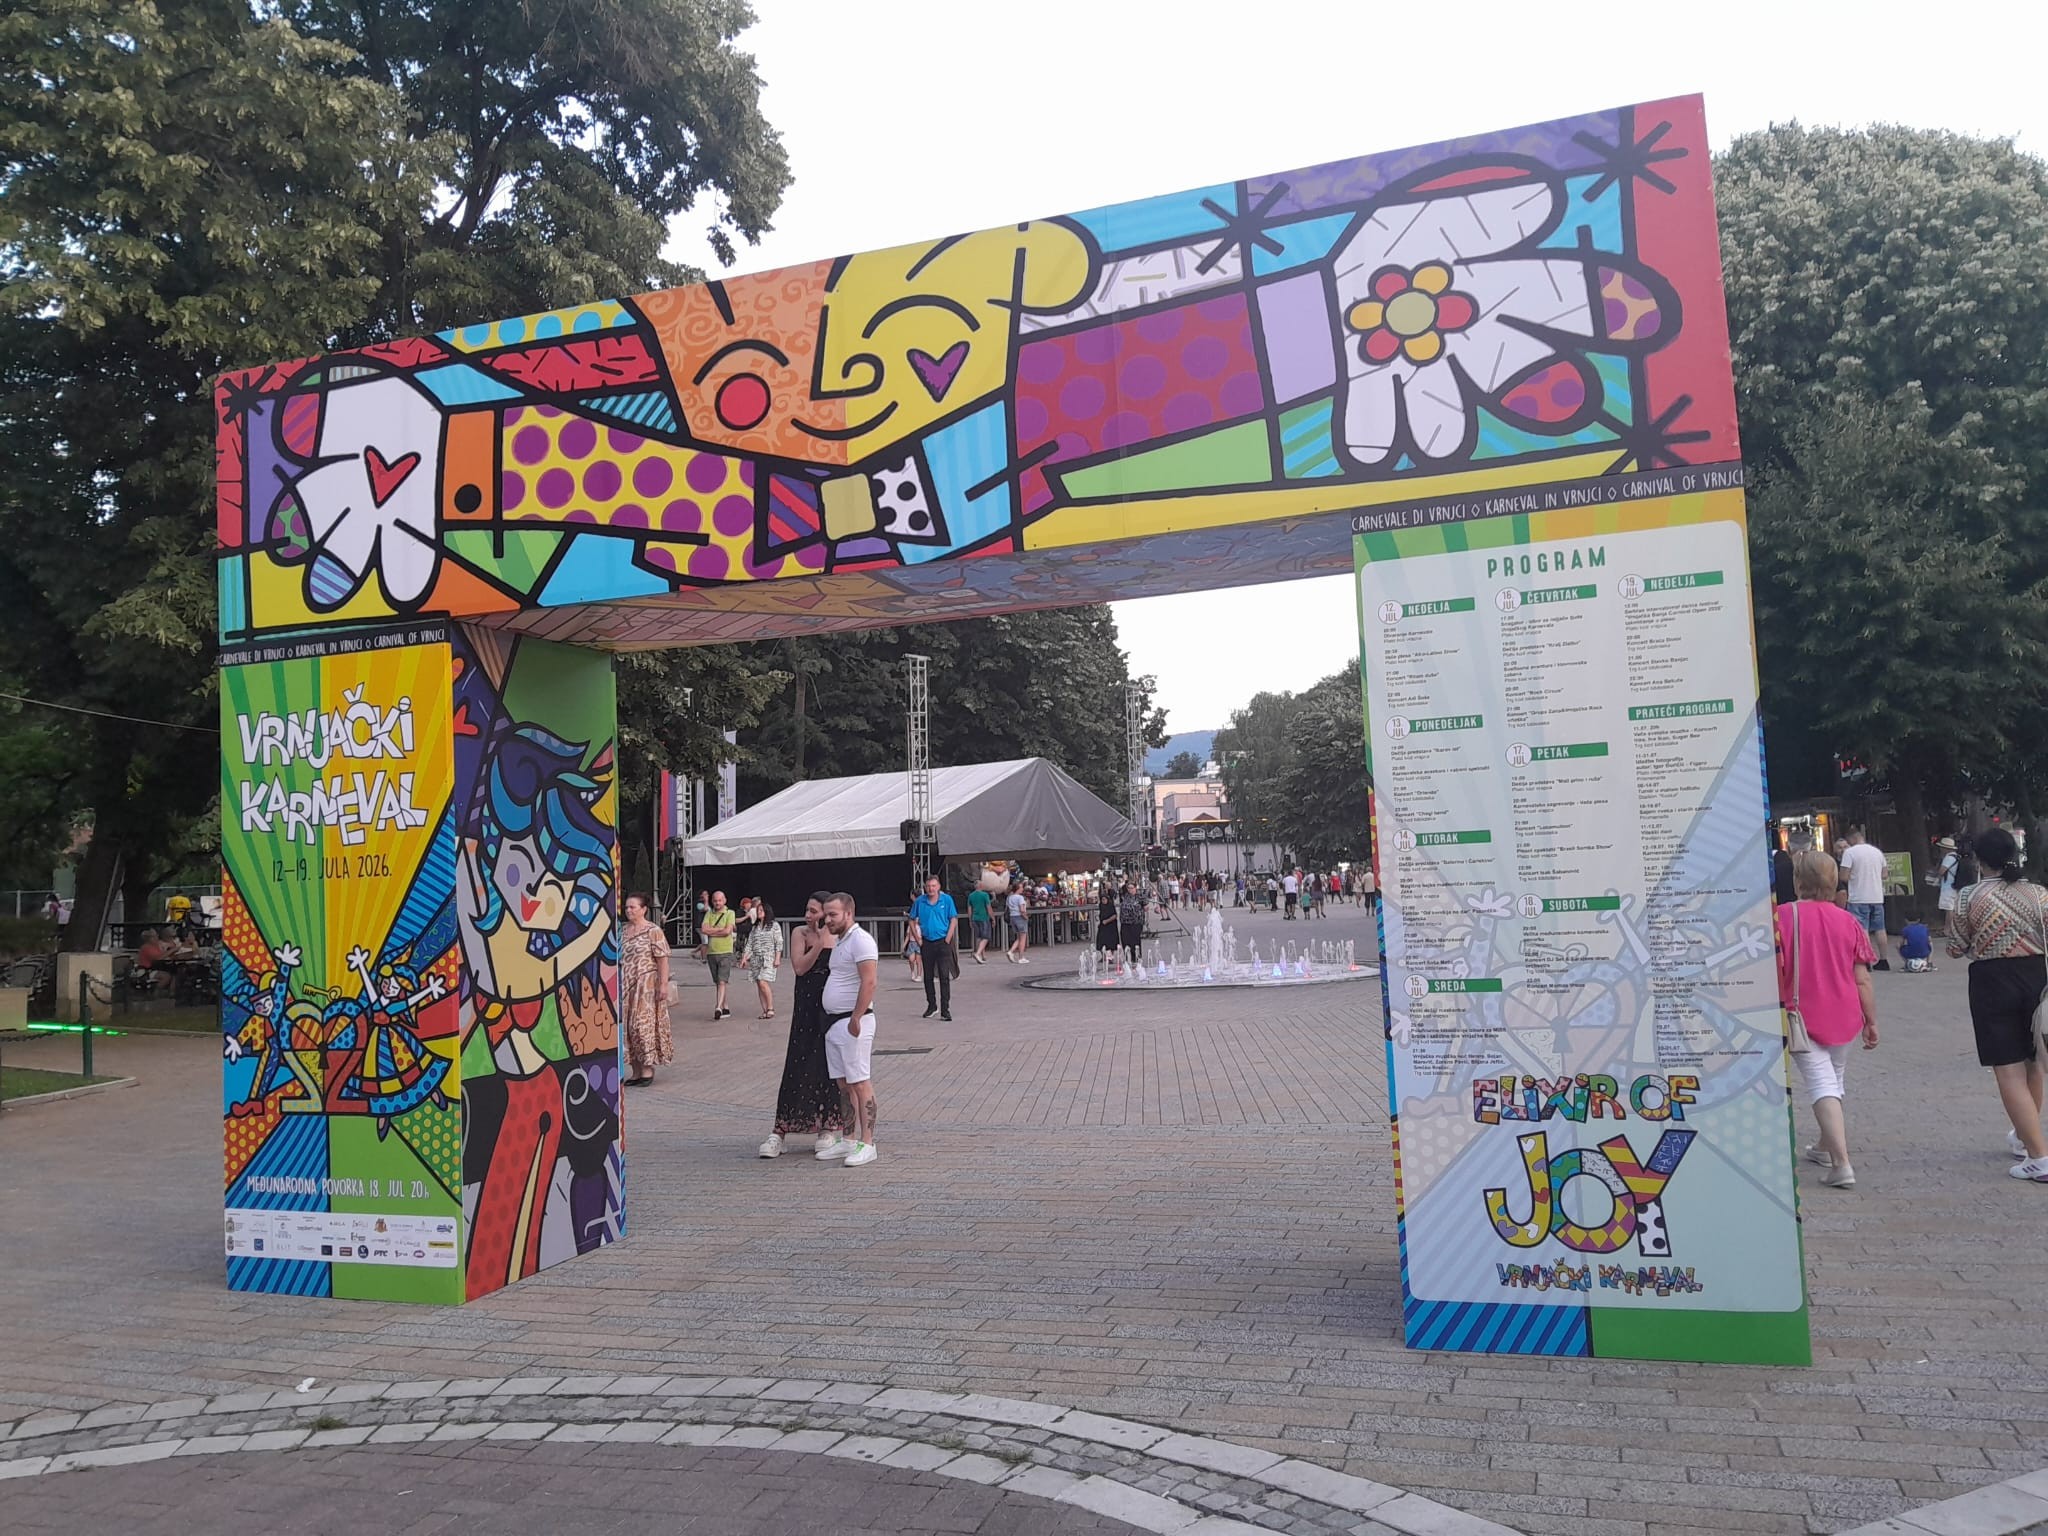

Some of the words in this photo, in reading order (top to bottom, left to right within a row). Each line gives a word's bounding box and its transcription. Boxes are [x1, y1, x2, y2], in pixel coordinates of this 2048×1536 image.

[1352, 512, 1407, 531] CARNEVALE
[1413, 510, 1423, 524] DI
[1429, 505, 1466, 522] VRNJCI
[1486, 494, 1539, 515] KARNEVAL
[1545, 493, 1557, 508] IN
[1563, 487, 1601, 505] VRNJCI
[1623, 477, 1676, 497] CARNIVAL
[1683, 475, 1696, 490] OF
[1703, 470, 1744, 488] VRNJCI
[1487, 546, 1606, 578] PROGRAM
[1626, 577, 1639, 586] 19.
[1650, 576, 1696, 590] NEDELJA
[1527, 589, 1578, 603] ČETVRTAK
[1626, 587, 1639, 596] JUL
[1385, 603, 1394, 612] 12.
[1408, 602, 1450, 615] NEDELJA
[1502, 600, 1515, 609] JUL
[1385, 612, 1397, 622] JUL
[219, 651, 251, 665] CARNEVALE
[255, 650, 261, 662] DI
[264, 648, 285, 661] VRNJCI
[296, 644, 325, 657] KARNEVAL
[330, 642, 337, 653] IN
[340, 640, 362, 652] VRNJCI
[374, 634, 405, 647] CARNIVAL
[409, 632, 417, 643] OF
[421, 629, 444, 642] VRNJCI
[1635, 706, 1675, 719] PRATEĆI
[1680, 702, 1726, 715] PROGRAM
[1415, 717, 1477, 731] PONEDELJAK
[1392, 728, 1405, 737] JUL
[1513, 746, 1523, 756] 17.
[1537, 747, 1569, 759] PETAK
[1513, 756, 1526, 765] JUL
[240, 770, 429, 846] KARNEVAL
[1422, 833, 1458, 844] UTORAK
[1400, 841, 1411, 849] JUL
[319, 857, 349, 879] JULA
[358, 853, 392, 877] 2026.
[1549, 899, 1588, 911] SUBOTA
[1525, 907, 1537, 916] JUL
[1410, 977, 1422, 986] 15.
[1434, 981, 1466, 991] SREDA
[1410, 987, 1423, 996] JUL
[1630, 1074, 1700, 1121] OF
[246, 1176, 316, 1195] MEĐUNARODNA
[322, 1178, 364, 1196] POVORKA
[388, 1179, 405, 1197] JUL
[1483, 1129, 1698, 1257] JOY
[1598, 1263, 1703, 1296] KARNEVAL
